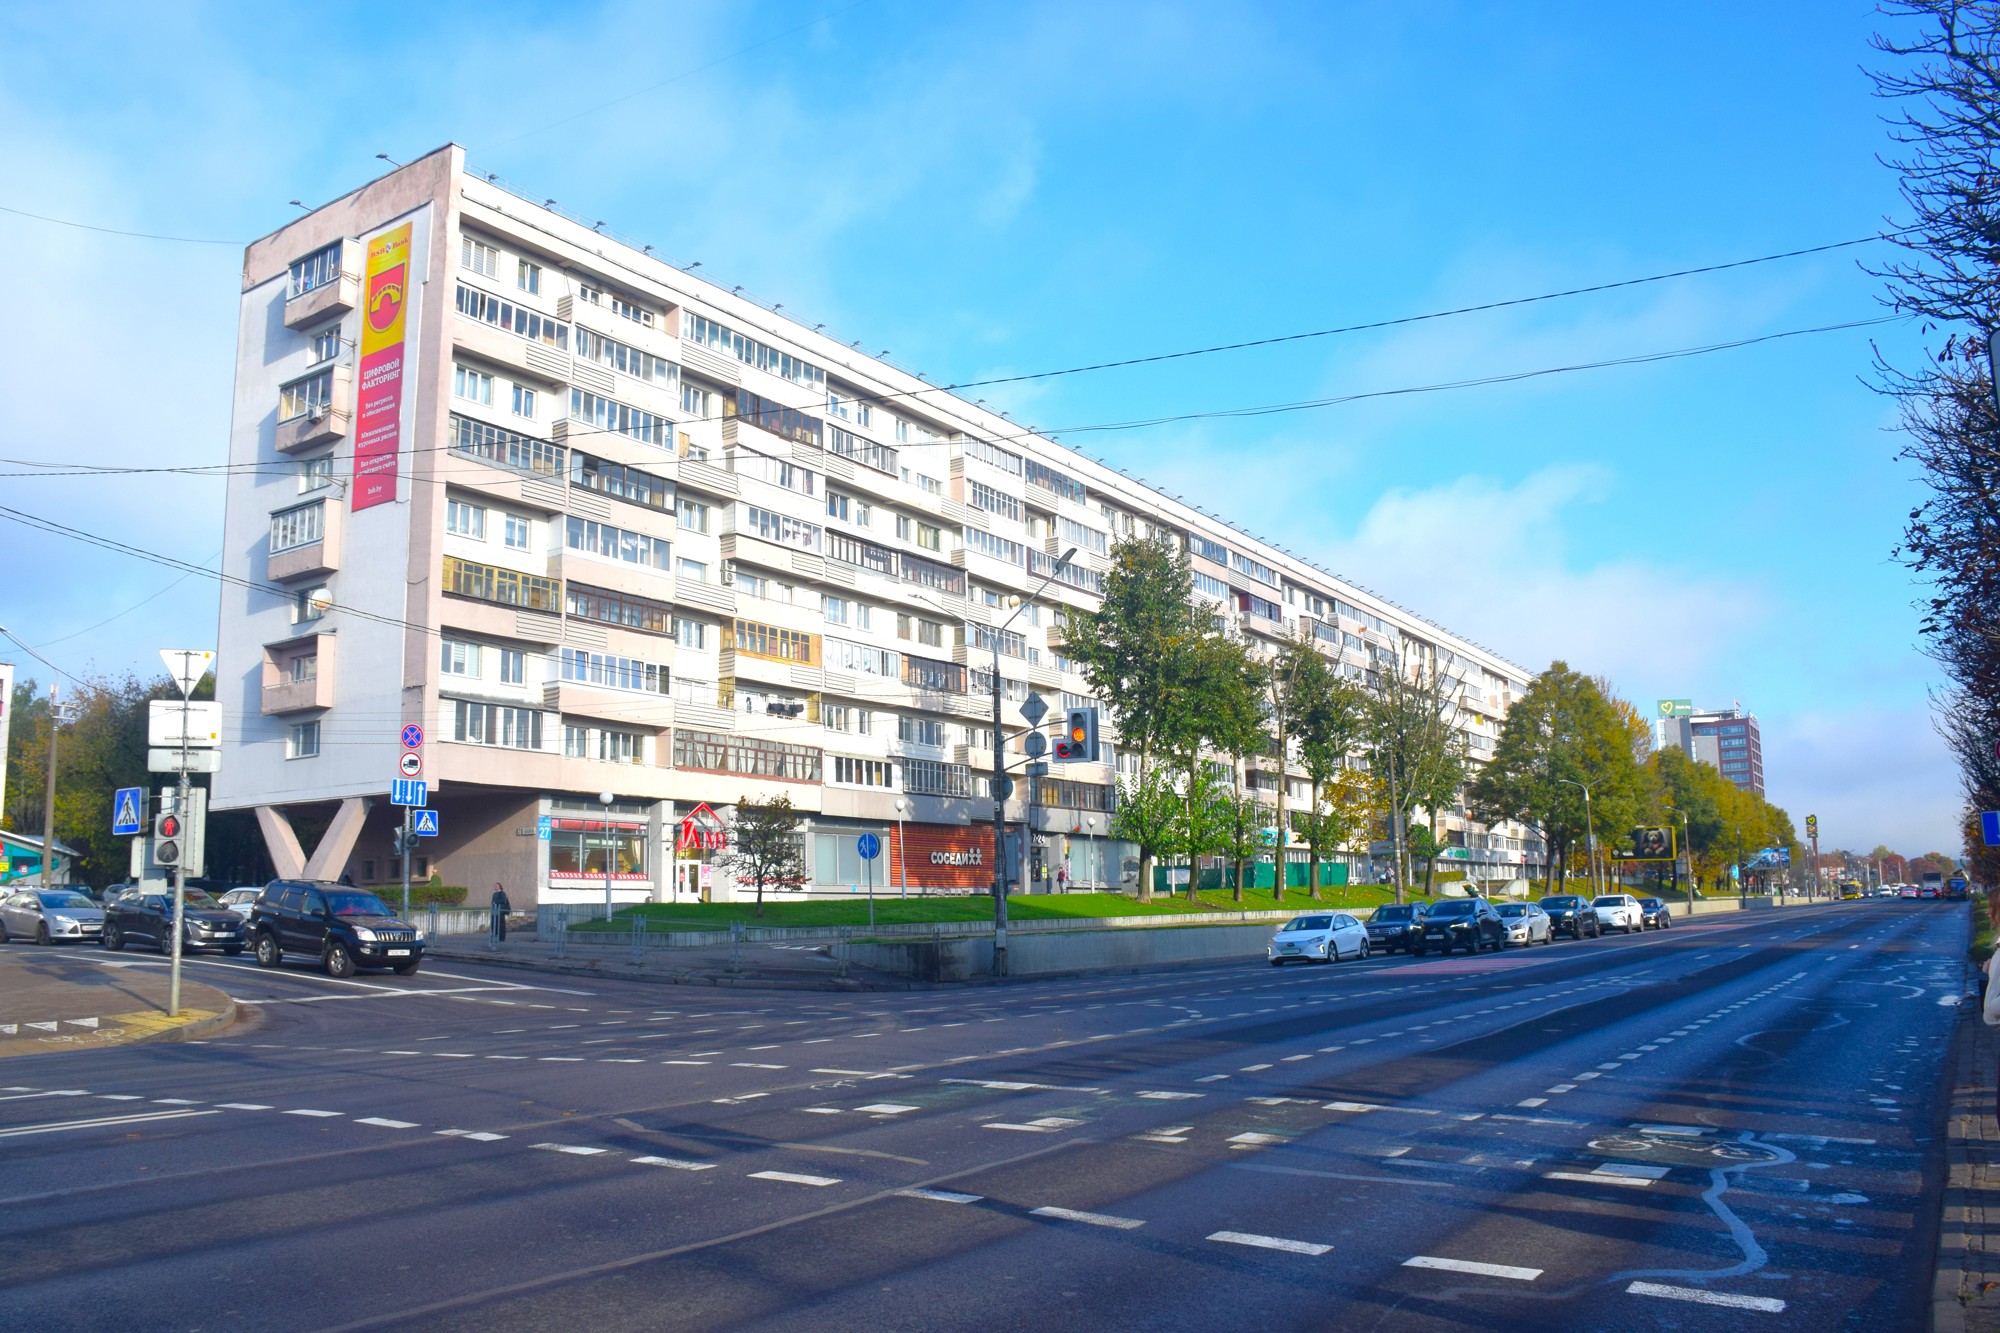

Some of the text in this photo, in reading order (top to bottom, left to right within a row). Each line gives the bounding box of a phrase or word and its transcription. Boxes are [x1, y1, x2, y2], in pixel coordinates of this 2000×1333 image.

[392, 236, 409, 248] Bank
[364, 358, 400, 380] ЦИФРОВОЙ
[362, 370, 401, 390] ФАКТОРИНГ
[539, 826, 550, 839] 27
